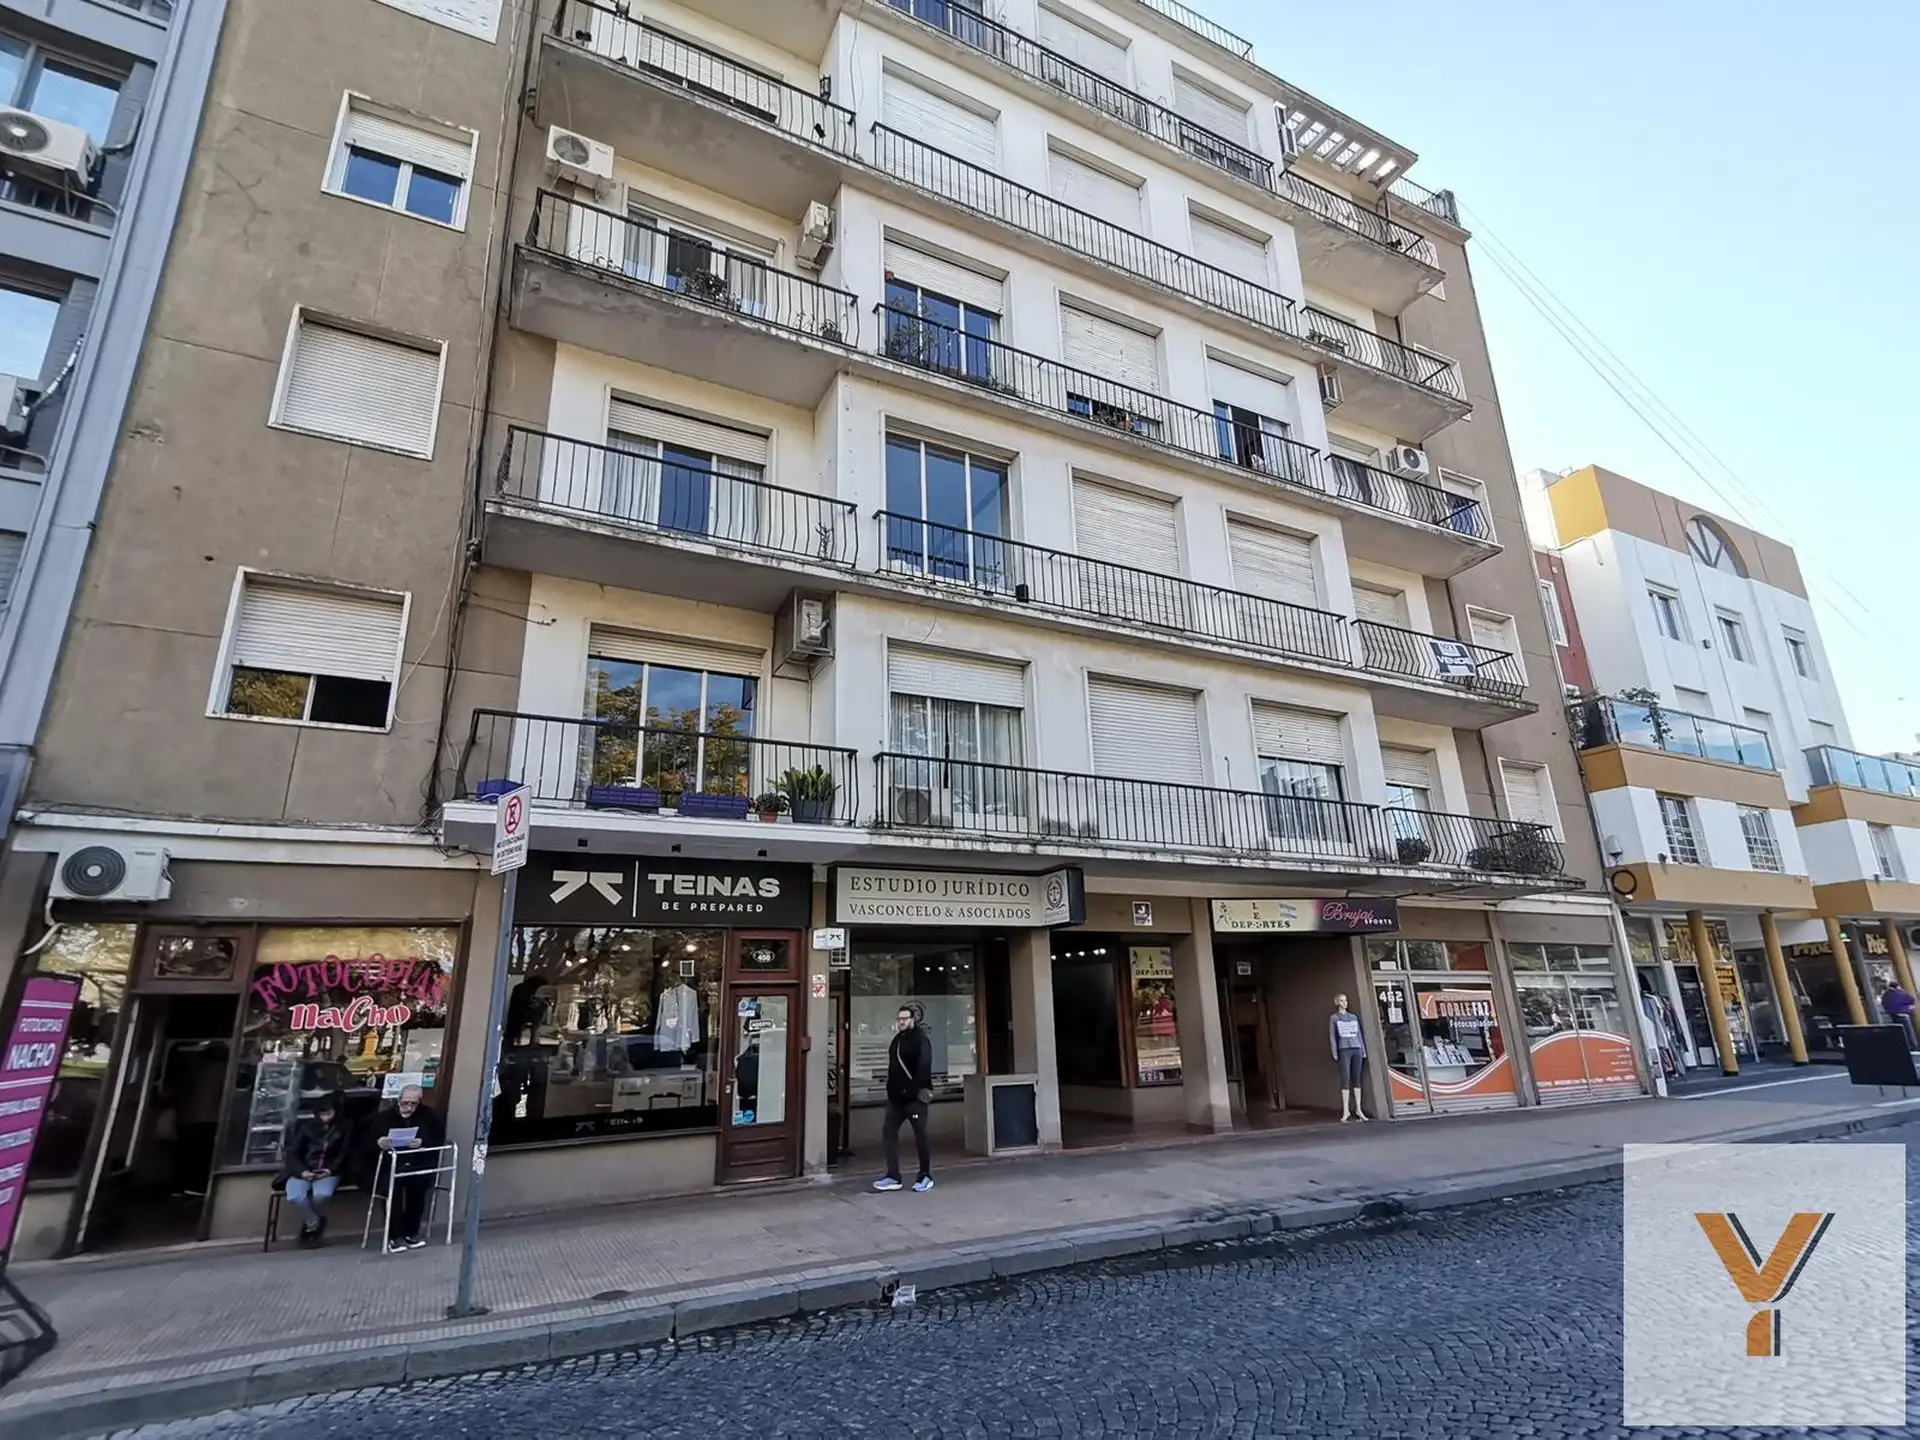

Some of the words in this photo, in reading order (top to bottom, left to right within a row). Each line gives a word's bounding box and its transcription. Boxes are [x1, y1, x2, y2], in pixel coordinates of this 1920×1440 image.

[648, 873, 780, 898] TEINAS
[850, 876, 937, 894] ESTUDIO
[942, 878, 1030, 897] JURÍDICO
[662, 901, 680, 910] BE
[690, 903, 764, 913] PREPARED
[849, 903, 941, 917] VASCONCELO
[945, 906, 954, 918] &
[958, 907, 1031, 919] ASOCIADOS
[7, 1041, 57, 1070] NACHO
